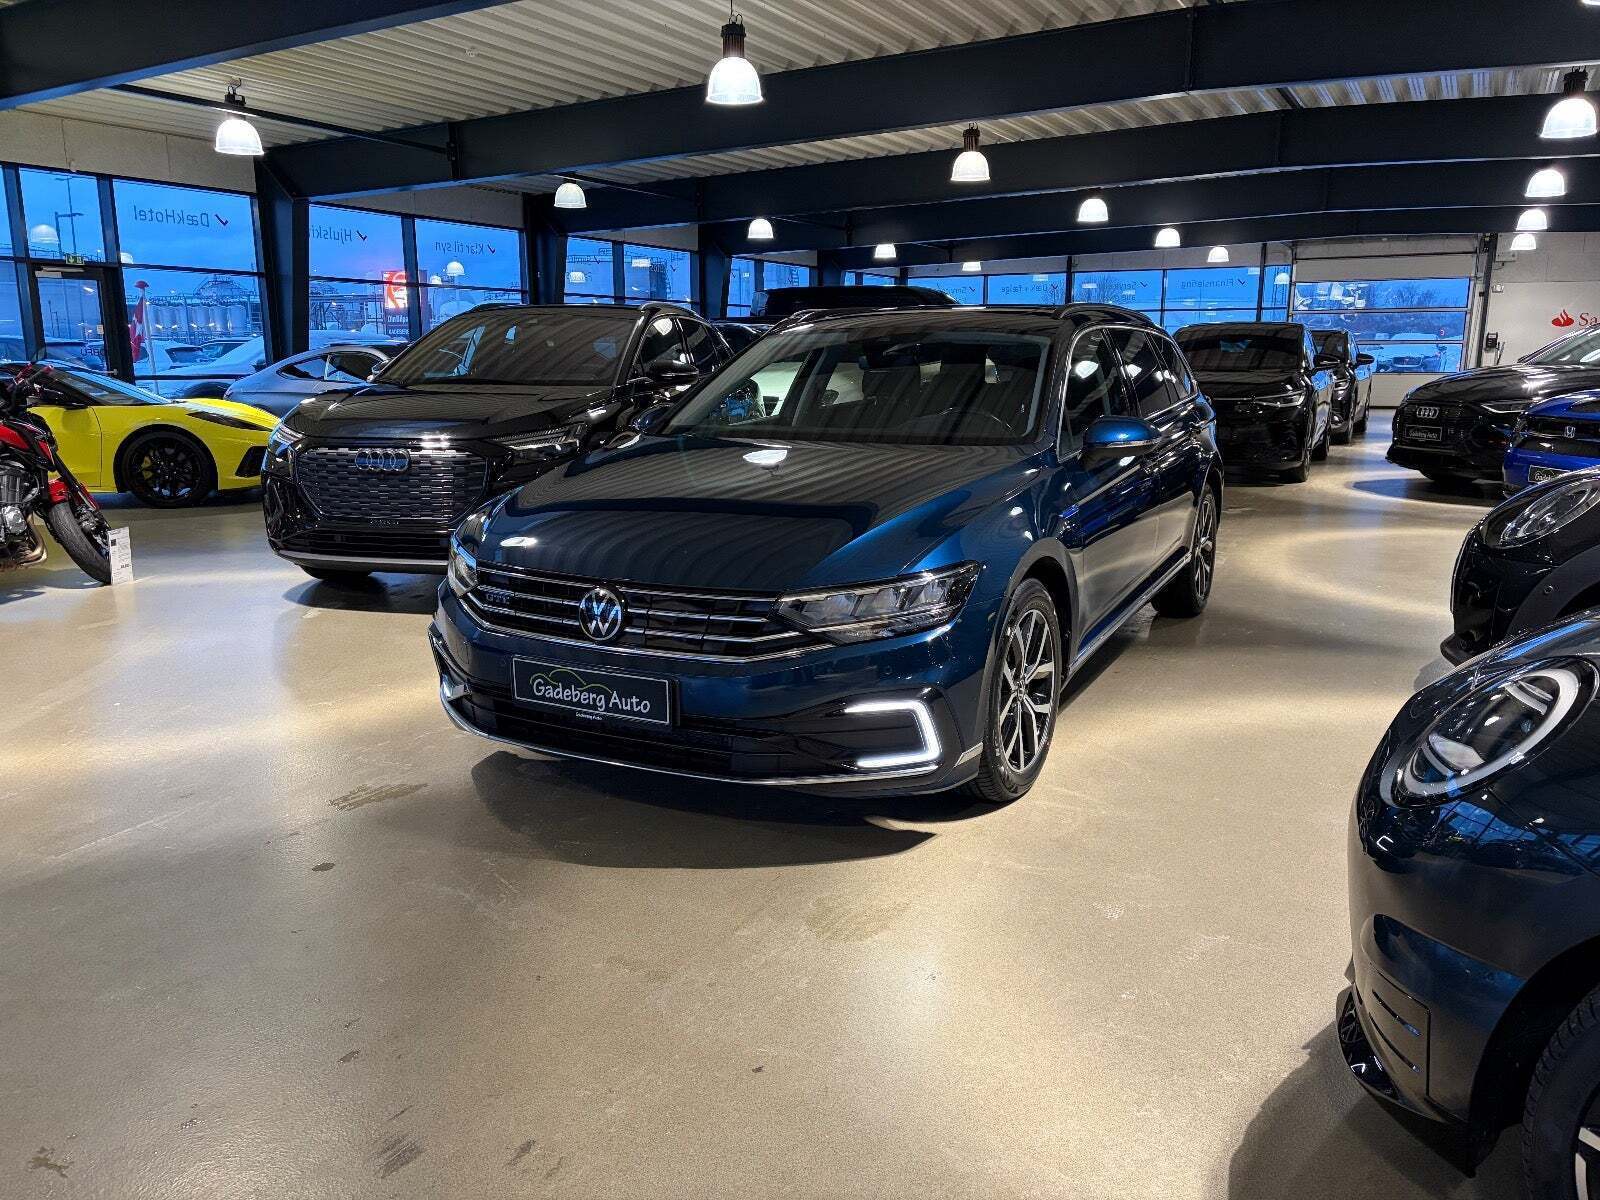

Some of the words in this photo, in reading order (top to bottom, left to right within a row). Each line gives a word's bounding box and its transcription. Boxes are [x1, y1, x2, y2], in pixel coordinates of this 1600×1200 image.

[1579, 313, 1598, 326] Sa
[533, 678, 605, 712] Gadeberg
[609, 690, 650, 713] Auto
